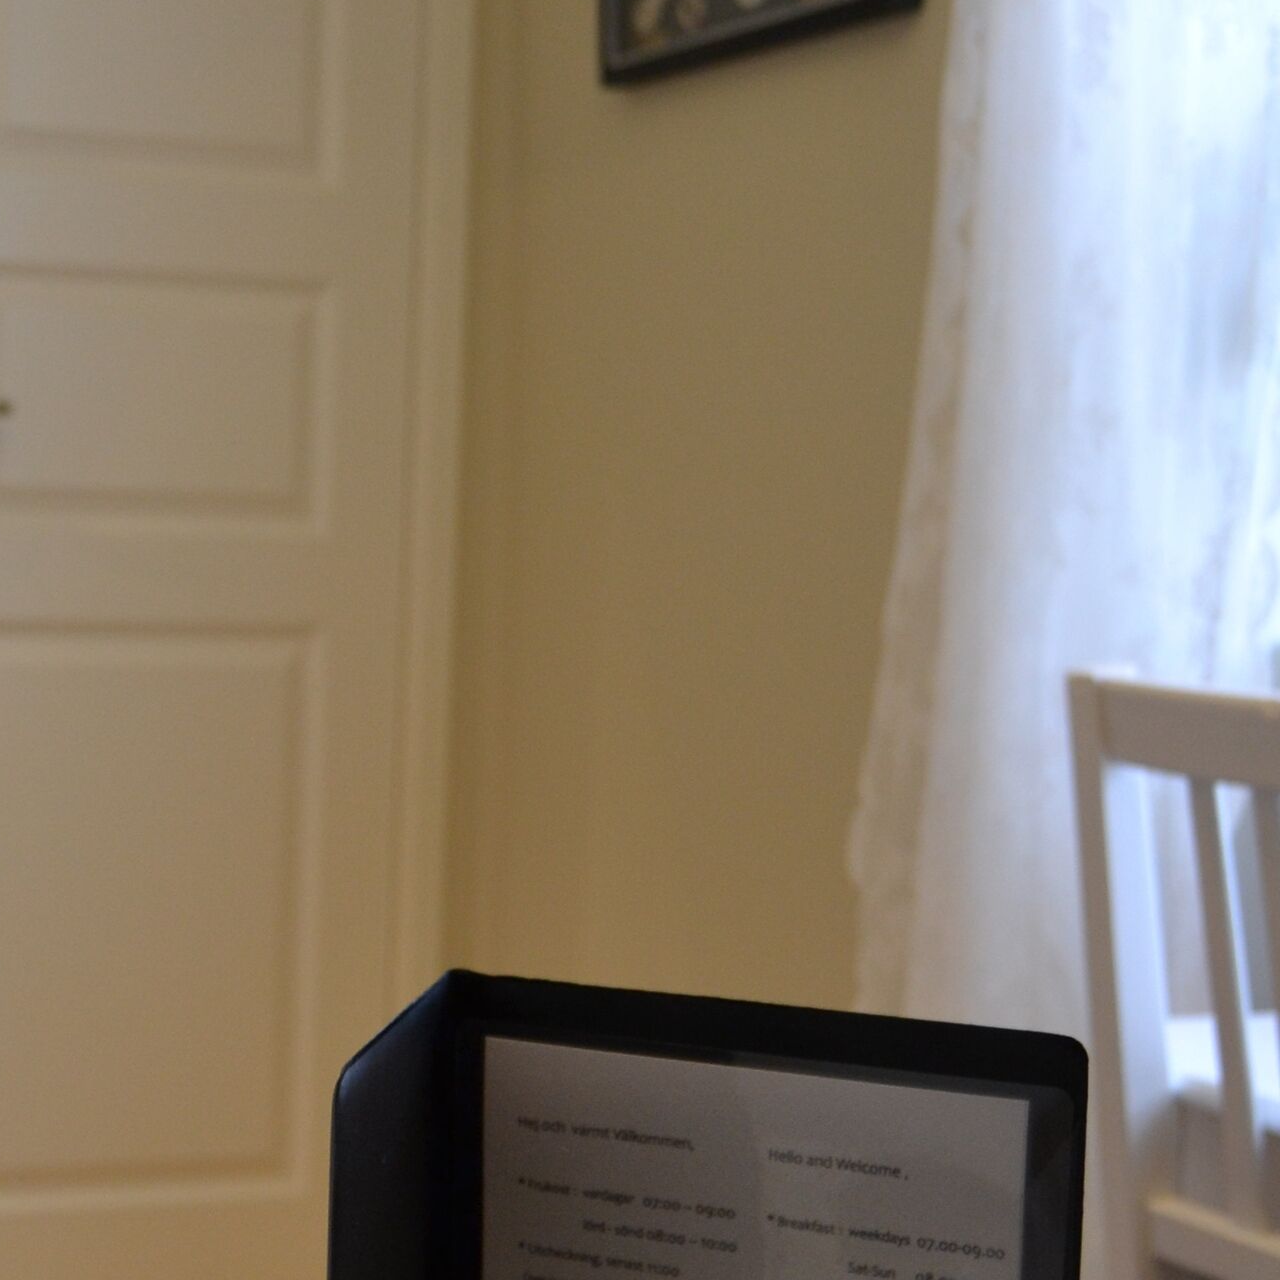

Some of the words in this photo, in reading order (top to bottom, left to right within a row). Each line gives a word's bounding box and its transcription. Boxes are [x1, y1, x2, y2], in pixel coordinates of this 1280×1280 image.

[768, 1150, 803, 1164] Hello
[806, 1156, 832, 1168] and
[835, 1158, 901, 1178] Welcome
[777, 1215, 834, 1233] Breakfast
[848, 1228, 910, 1246] weekdays
[916, 1237, 1005, 1259] 07.00-09.00
